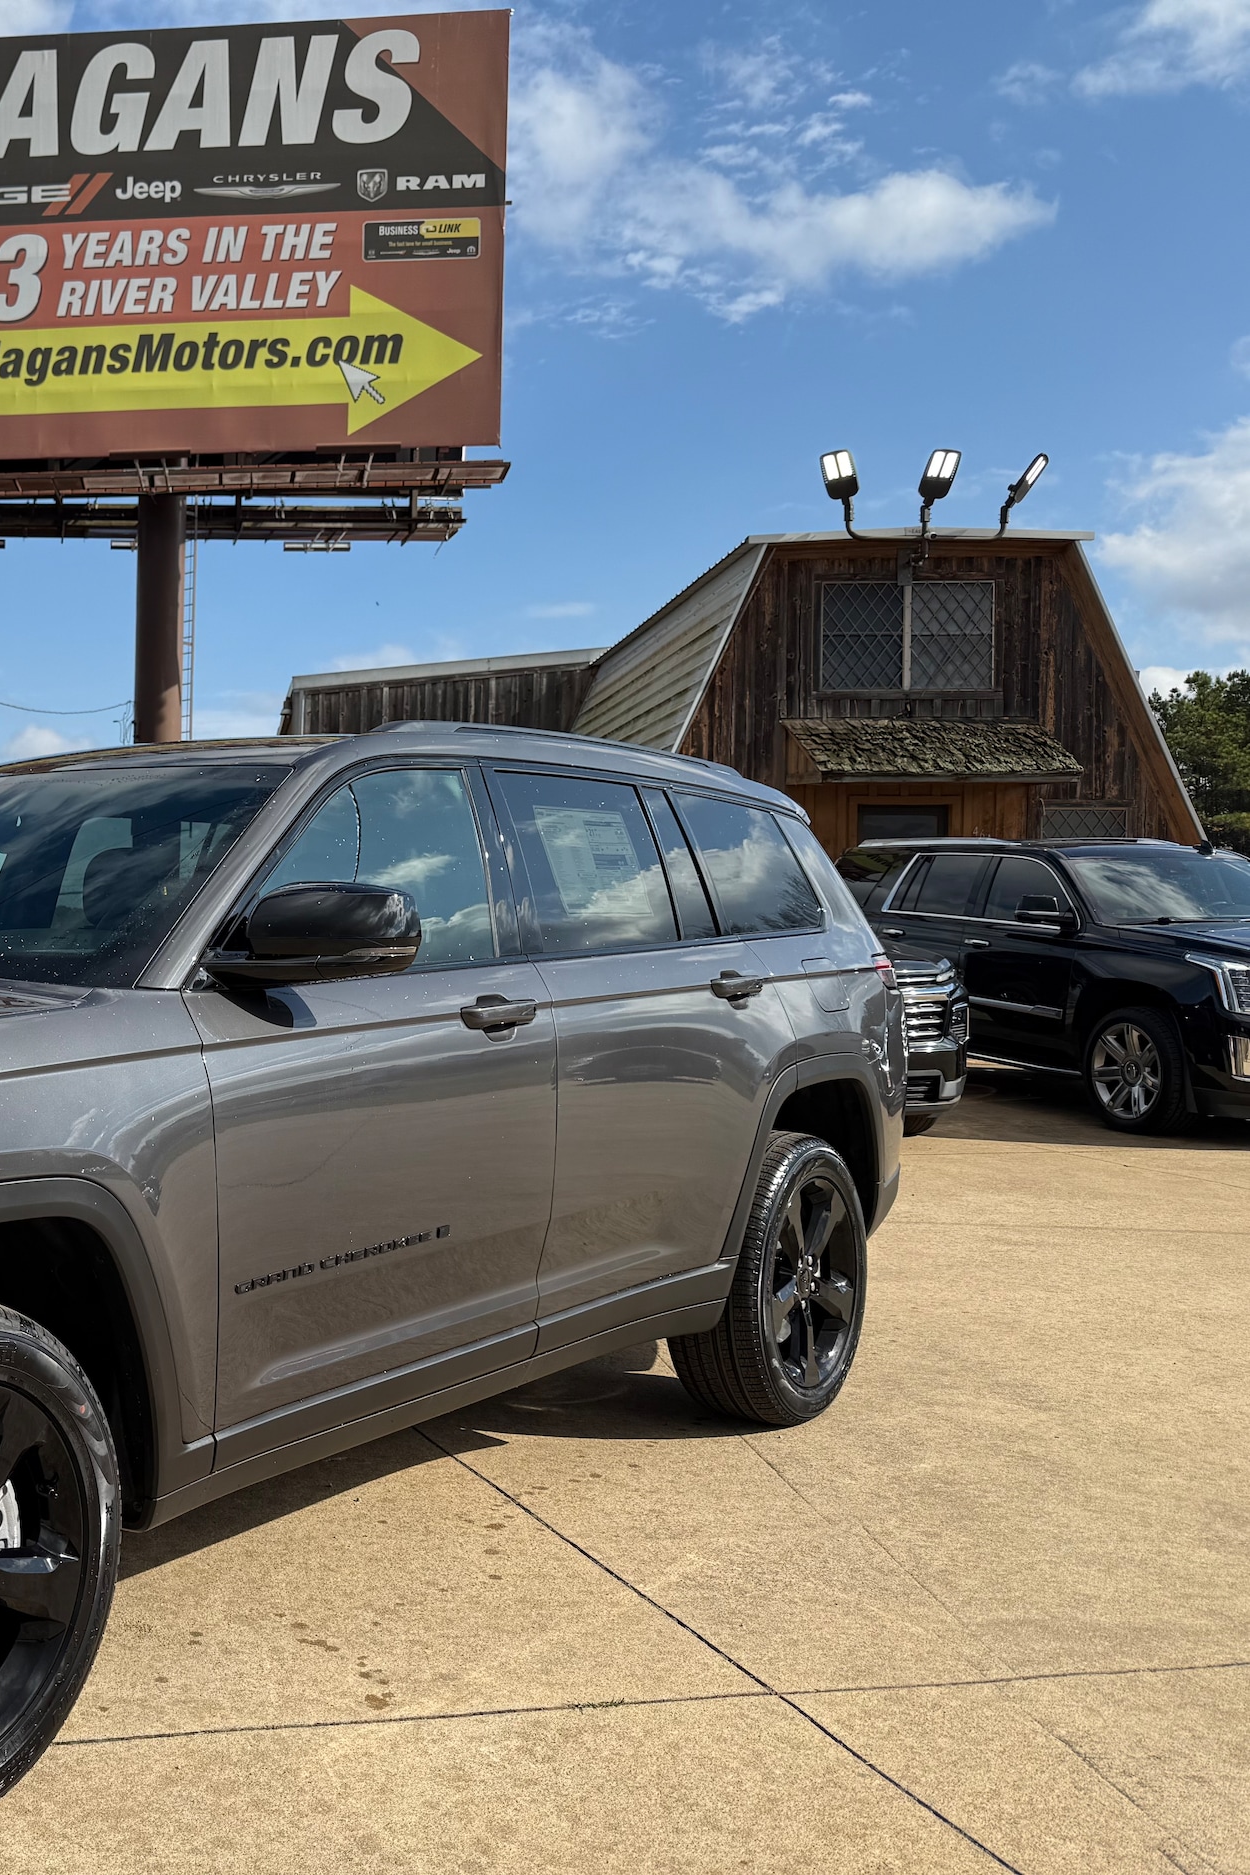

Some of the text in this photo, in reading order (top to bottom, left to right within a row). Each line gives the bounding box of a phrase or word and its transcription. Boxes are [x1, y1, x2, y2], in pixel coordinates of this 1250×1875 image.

[115, 176, 182, 203] Jeep
[213, 171, 322, 184] CHRYSLER
[396, 173, 486, 191] RAM
[438, 223, 461, 234] LINK
[61, 222, 338, 270] YEARS IN THE
[56, 270, 342, 318] RIVER VALLEY
[234, 1262, 315, 1295] GRAND
[319, 1230, 433, 1270] CHEROKEE
